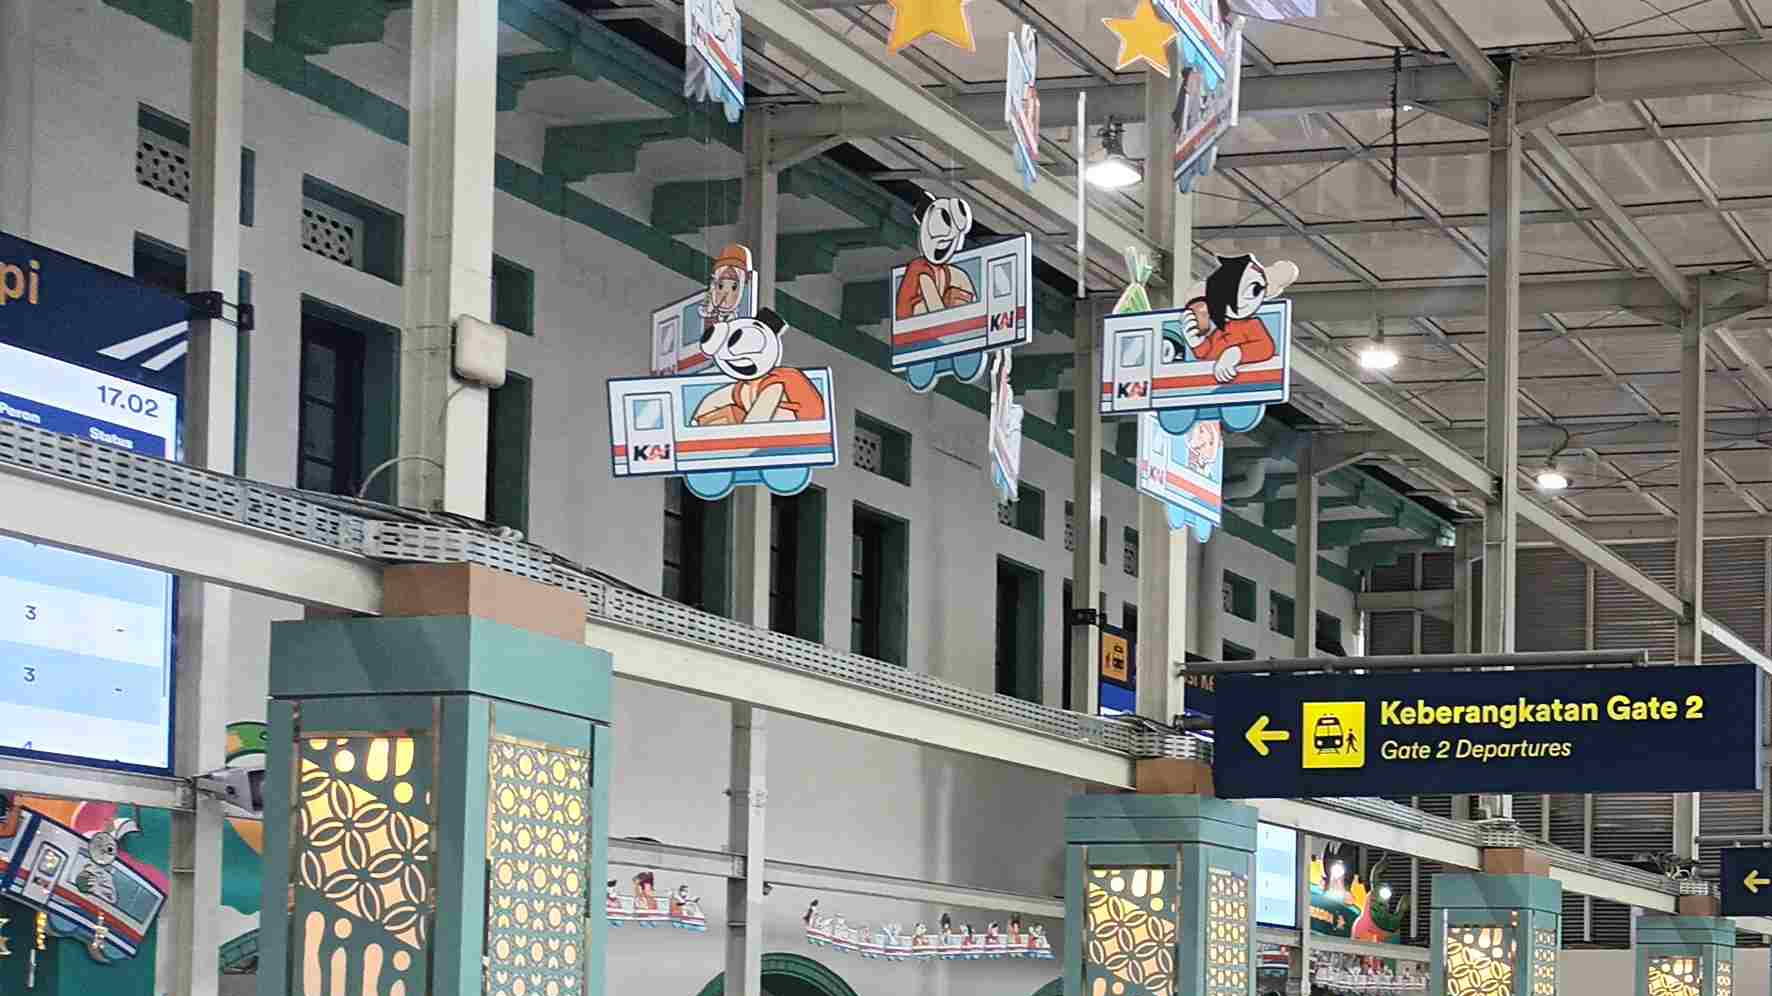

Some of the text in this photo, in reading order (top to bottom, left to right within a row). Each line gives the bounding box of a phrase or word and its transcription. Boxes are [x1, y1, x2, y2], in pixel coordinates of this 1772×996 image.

[97, 385, 159, 418] 17.02
[24, 604, 37, 621] 3
[23, 666, 36, 683] 3
[1380, 695, 1704, 729] Keberangkatan Gate 2
[1381, 739, 1573, 763] Gate 2 Departures
